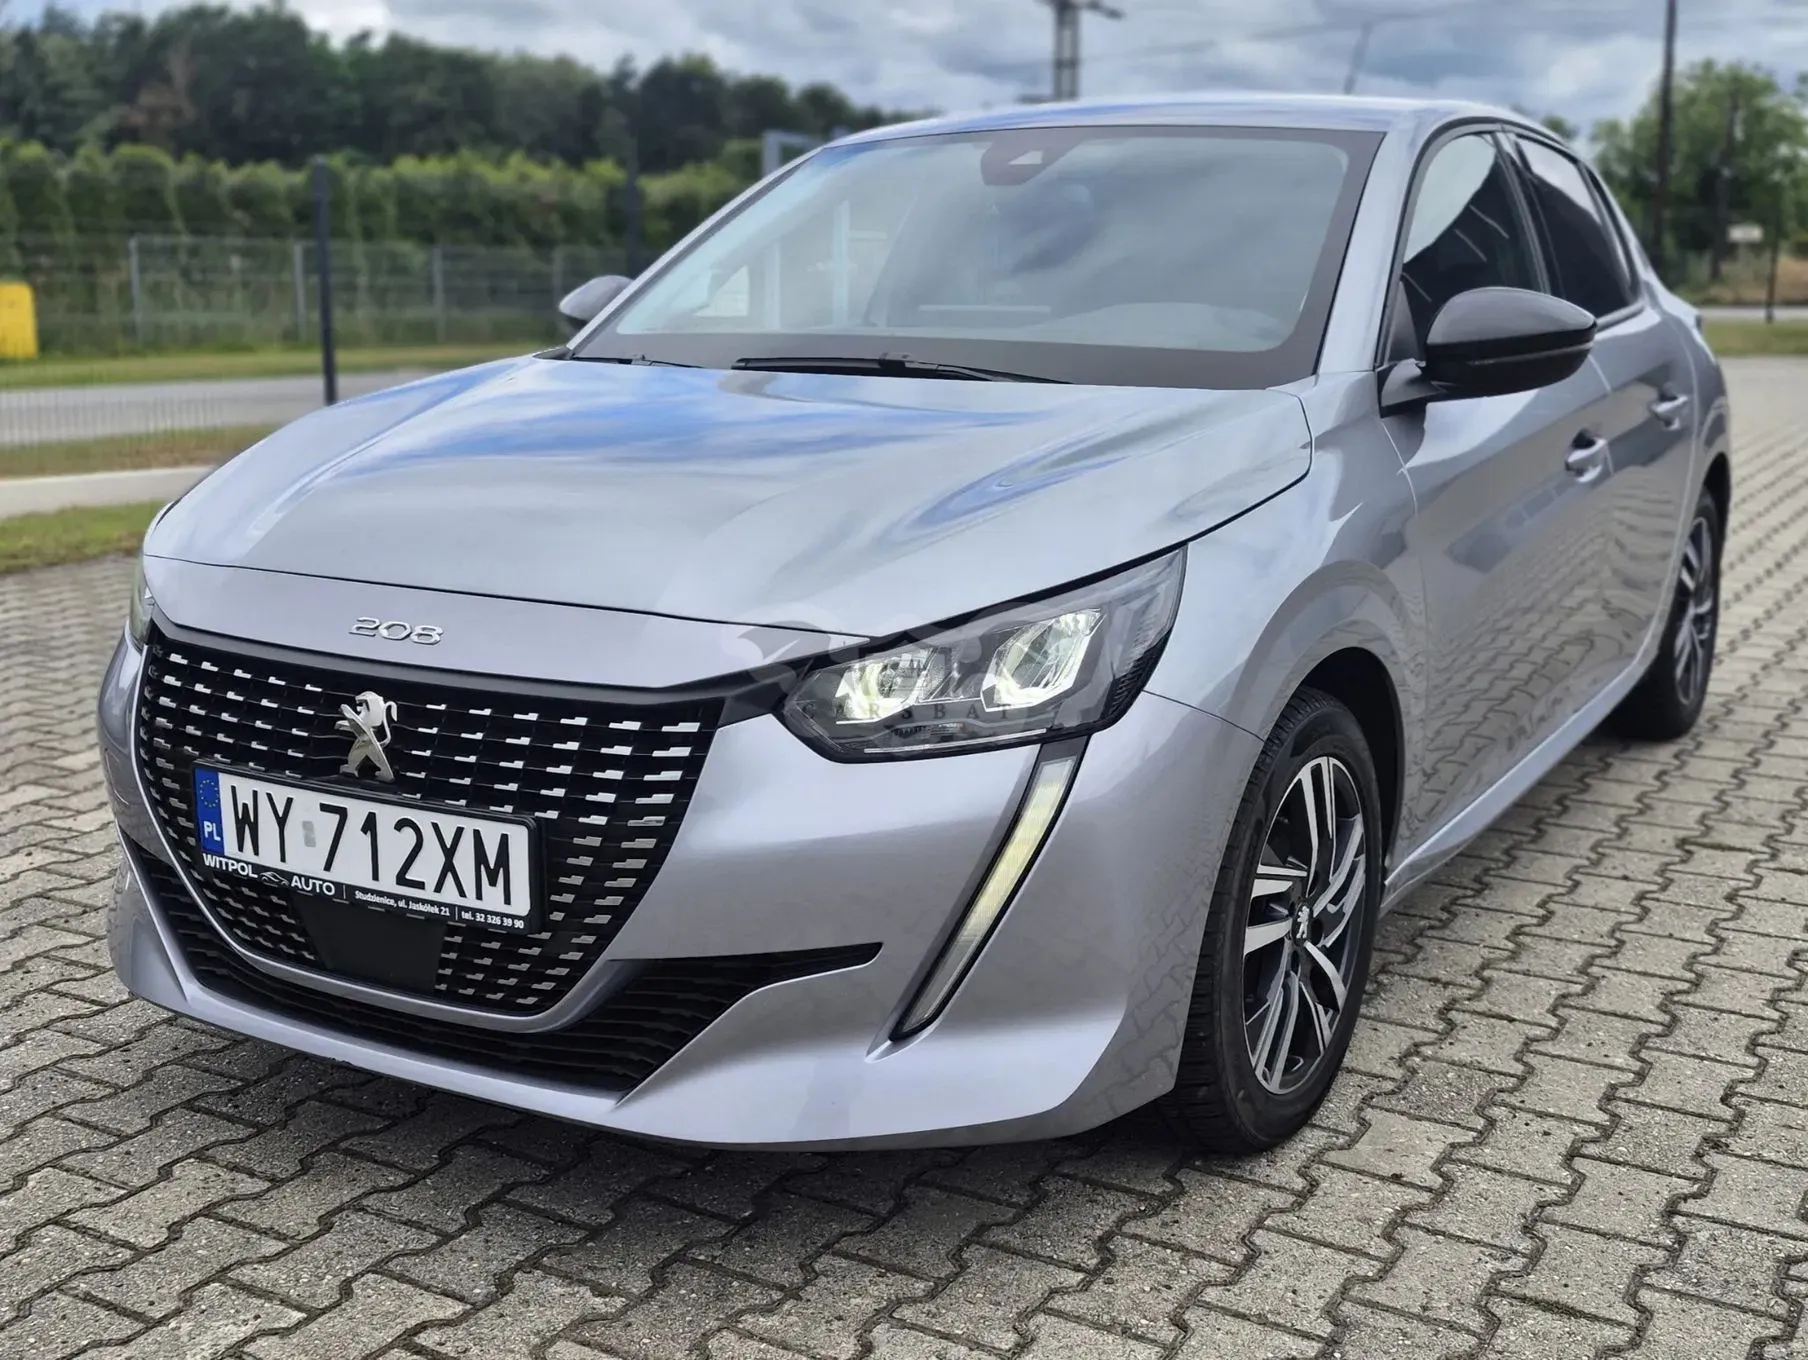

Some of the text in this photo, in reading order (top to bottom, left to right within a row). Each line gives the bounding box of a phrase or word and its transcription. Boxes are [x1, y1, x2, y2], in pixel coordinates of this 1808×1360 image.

[350, 616, 444, 645] 208
[203, 821, 221, 841] PL
[231, 785, 512, 906] WY 712XM
[202, 853, 335, 896] WITPOL AUTO
[440, 906, 450, 916] 21
[461, 911, 525, 929] tel. 32 326 39 90
